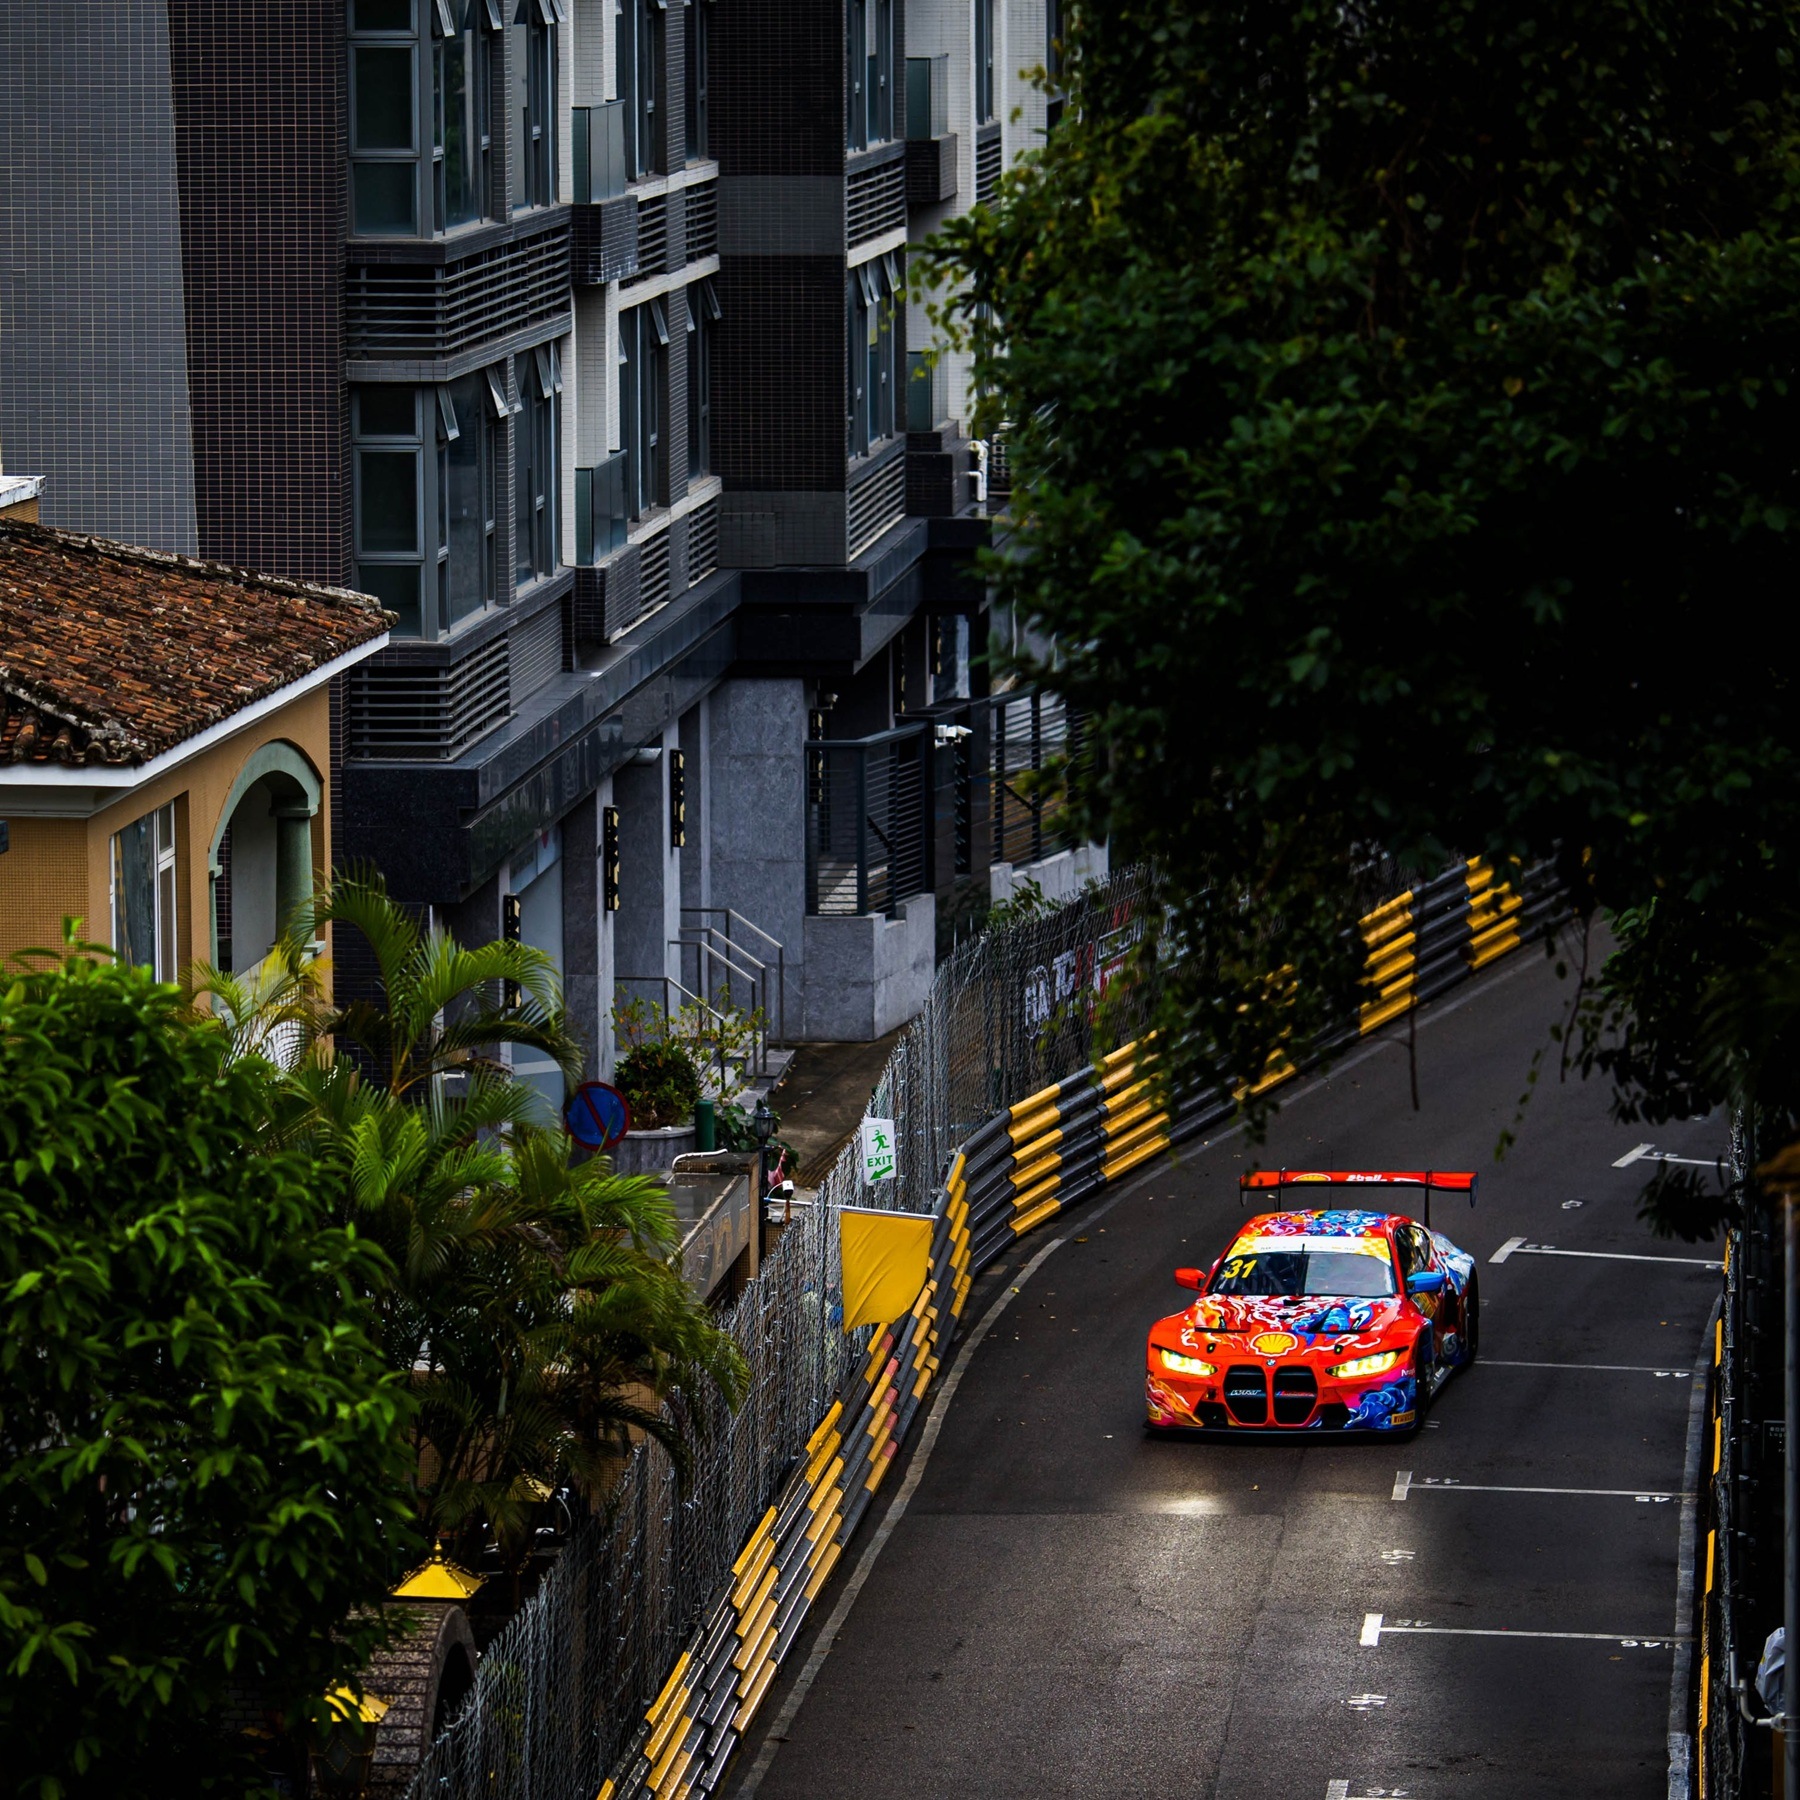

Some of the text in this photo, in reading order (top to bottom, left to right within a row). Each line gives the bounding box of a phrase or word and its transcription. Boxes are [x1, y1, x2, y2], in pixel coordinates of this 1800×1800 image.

[867, 1155, 893, 1168] EXIT
[1224, 1259, 1257, 1279] 31
[1620, 1639, 1661, 1648] 46
